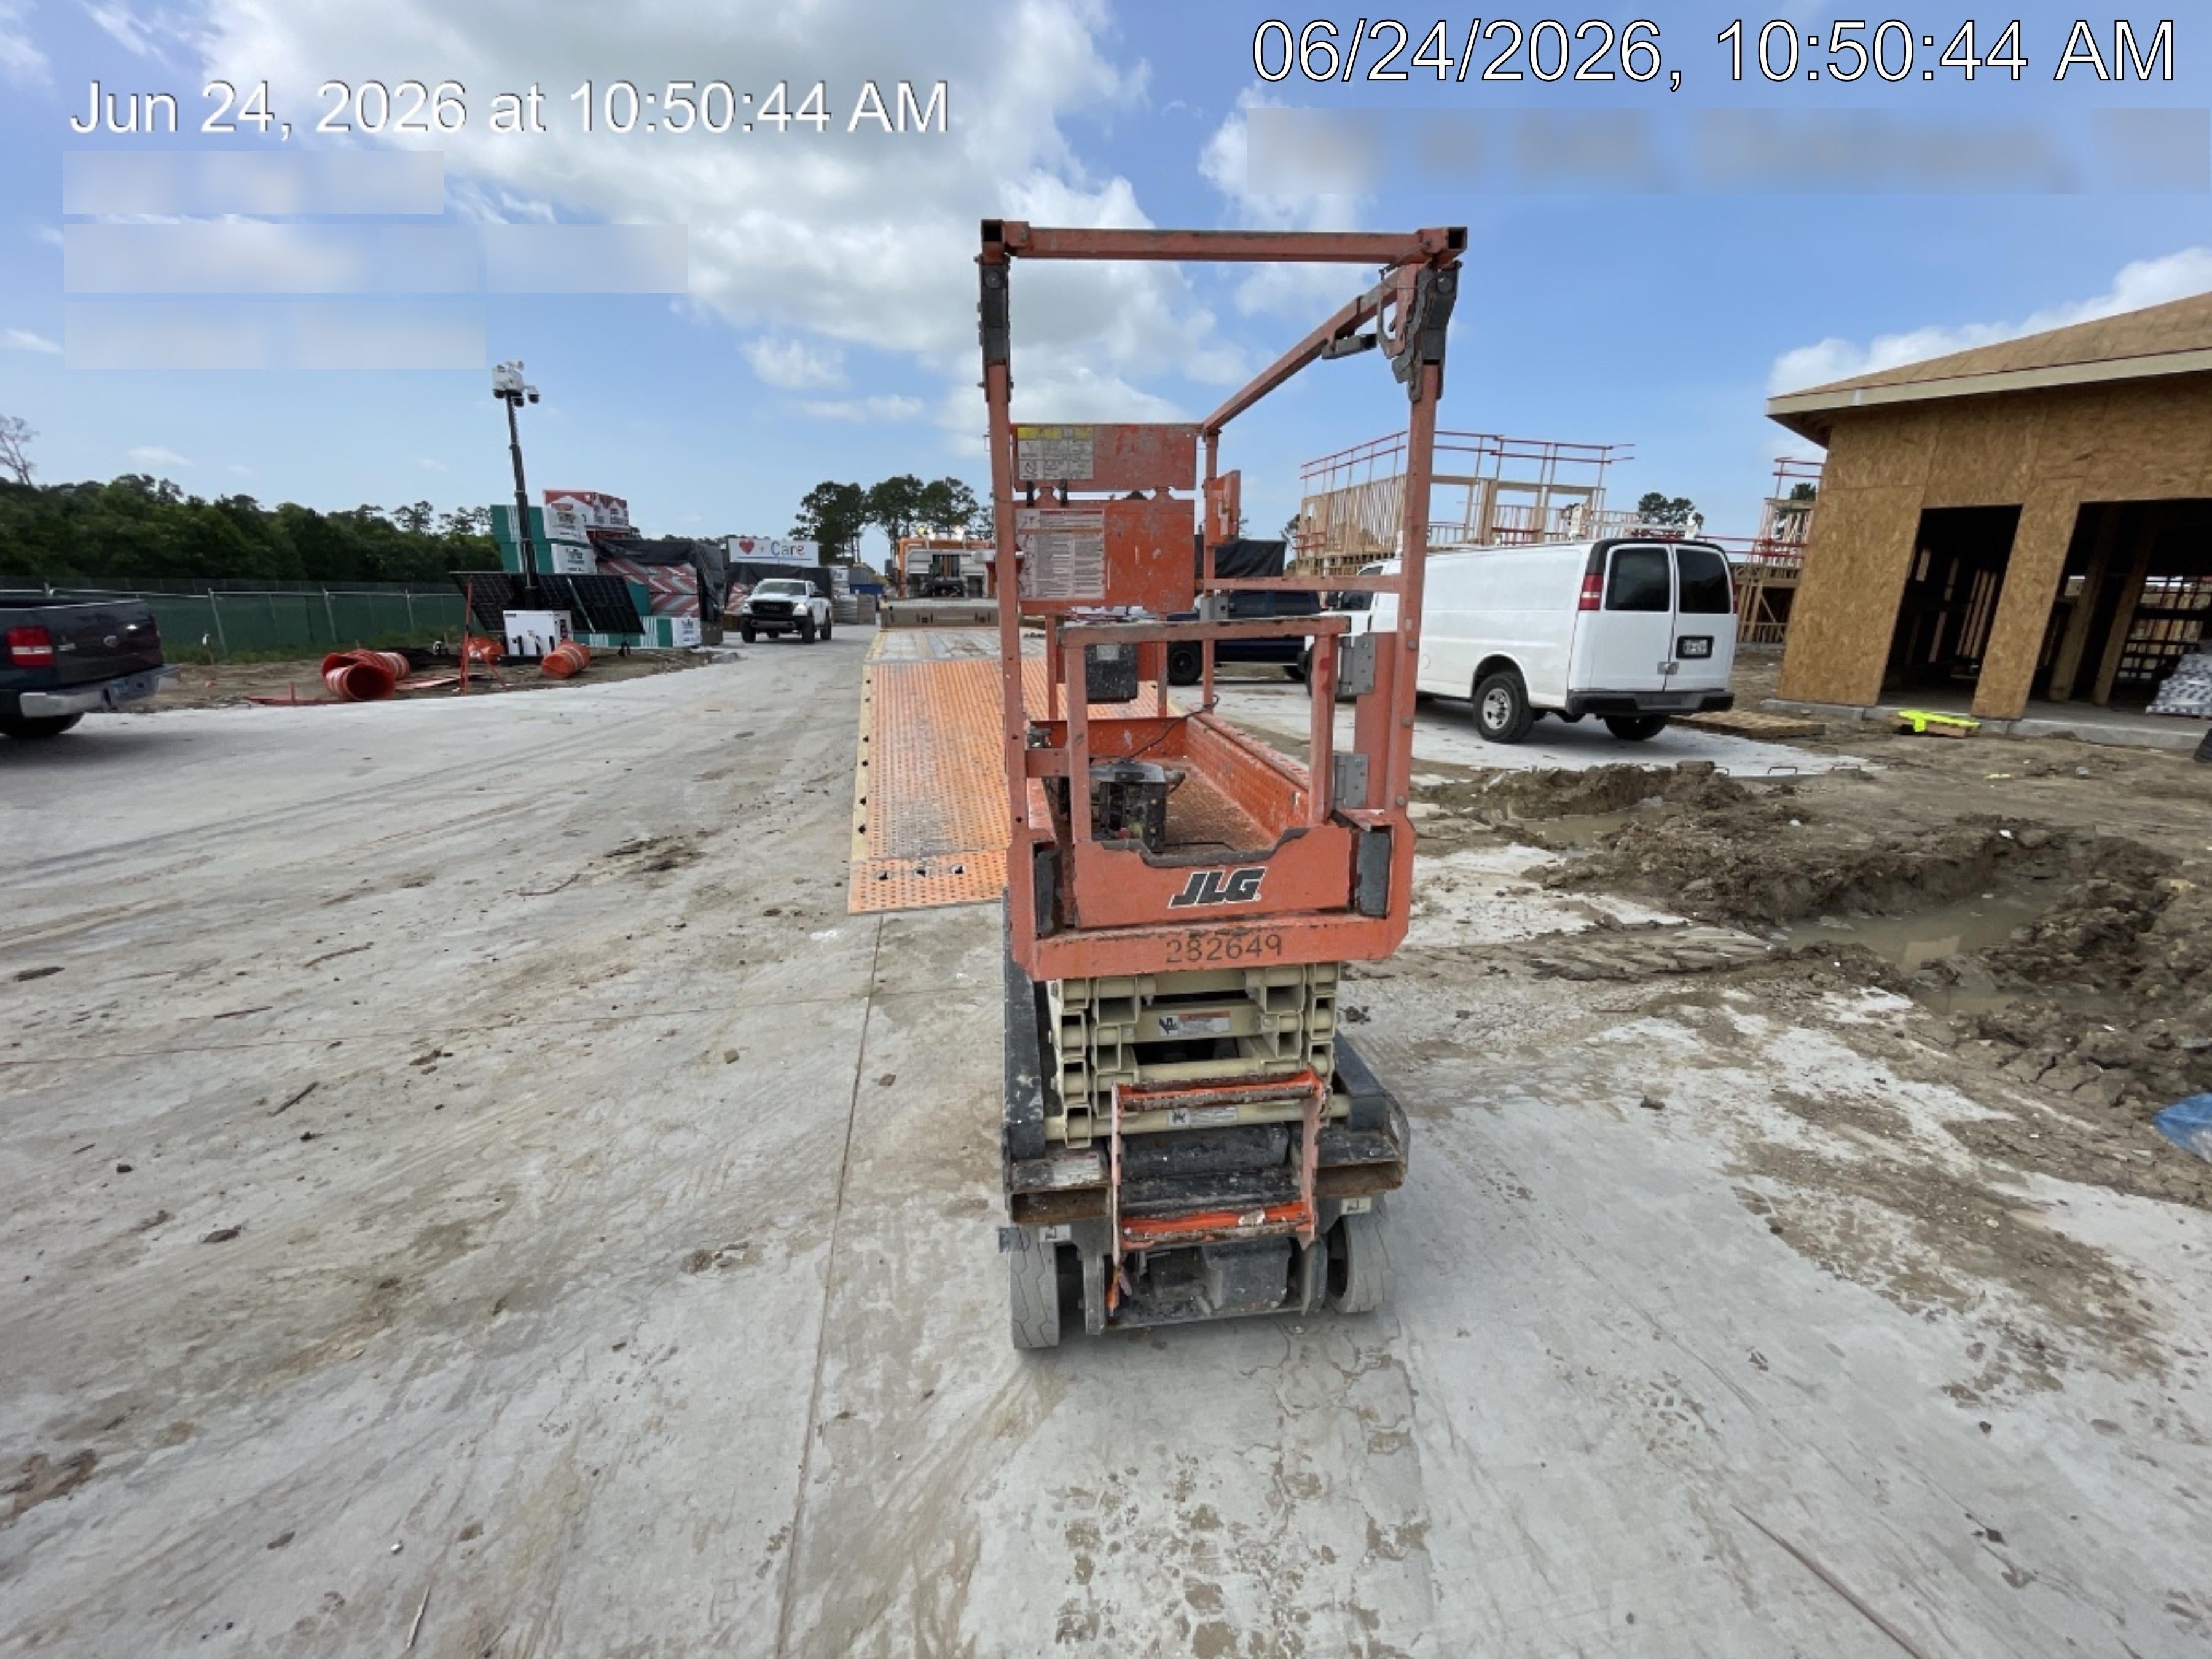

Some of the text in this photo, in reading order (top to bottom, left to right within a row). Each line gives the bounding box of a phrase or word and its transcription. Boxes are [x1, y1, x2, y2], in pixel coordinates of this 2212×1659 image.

[770, 540, 806, 556] Care
[1167, 867, 1267, 908] JLG
[1166, 933, 1282, 963] 282649
